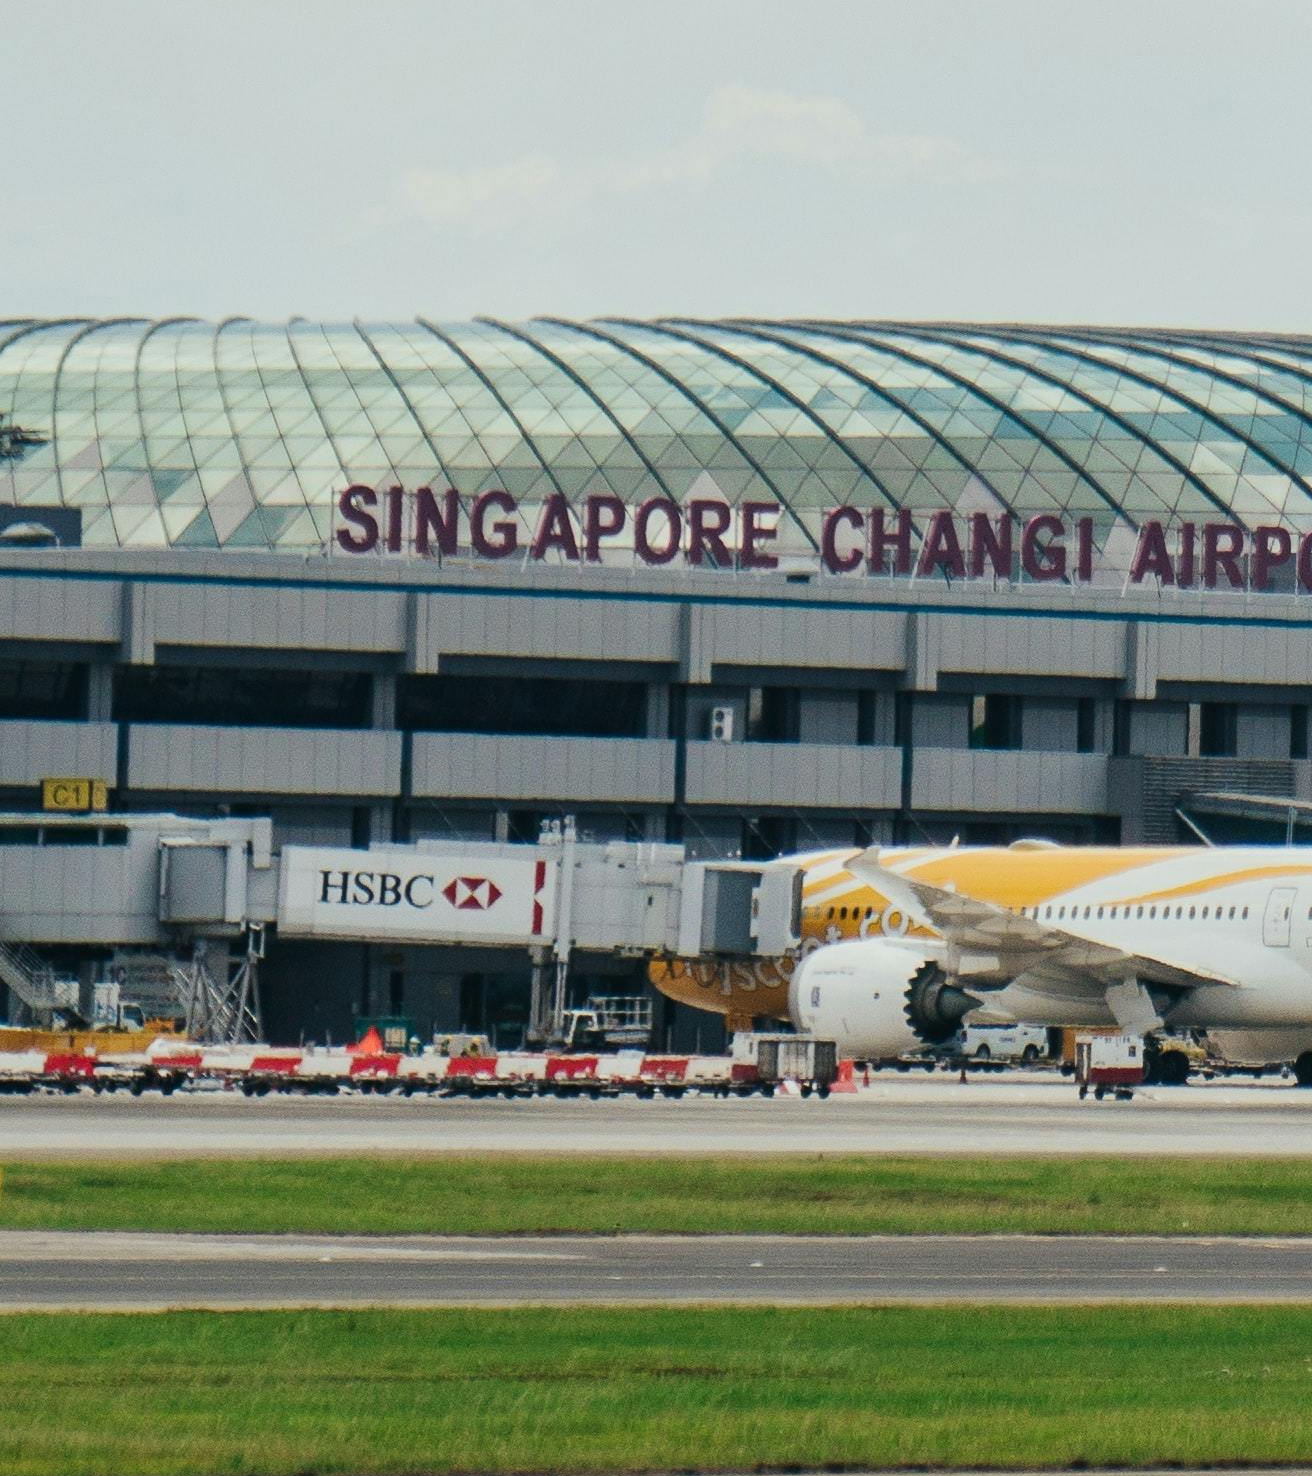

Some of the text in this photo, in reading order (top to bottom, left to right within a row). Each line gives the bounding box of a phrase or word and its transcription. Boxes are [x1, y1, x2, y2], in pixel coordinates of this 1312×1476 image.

[335, 484, 781, 569] SINGAPORE
[820, 505, 1094, 581] CHANGI
[318, 869, 435, 909] HSBC
